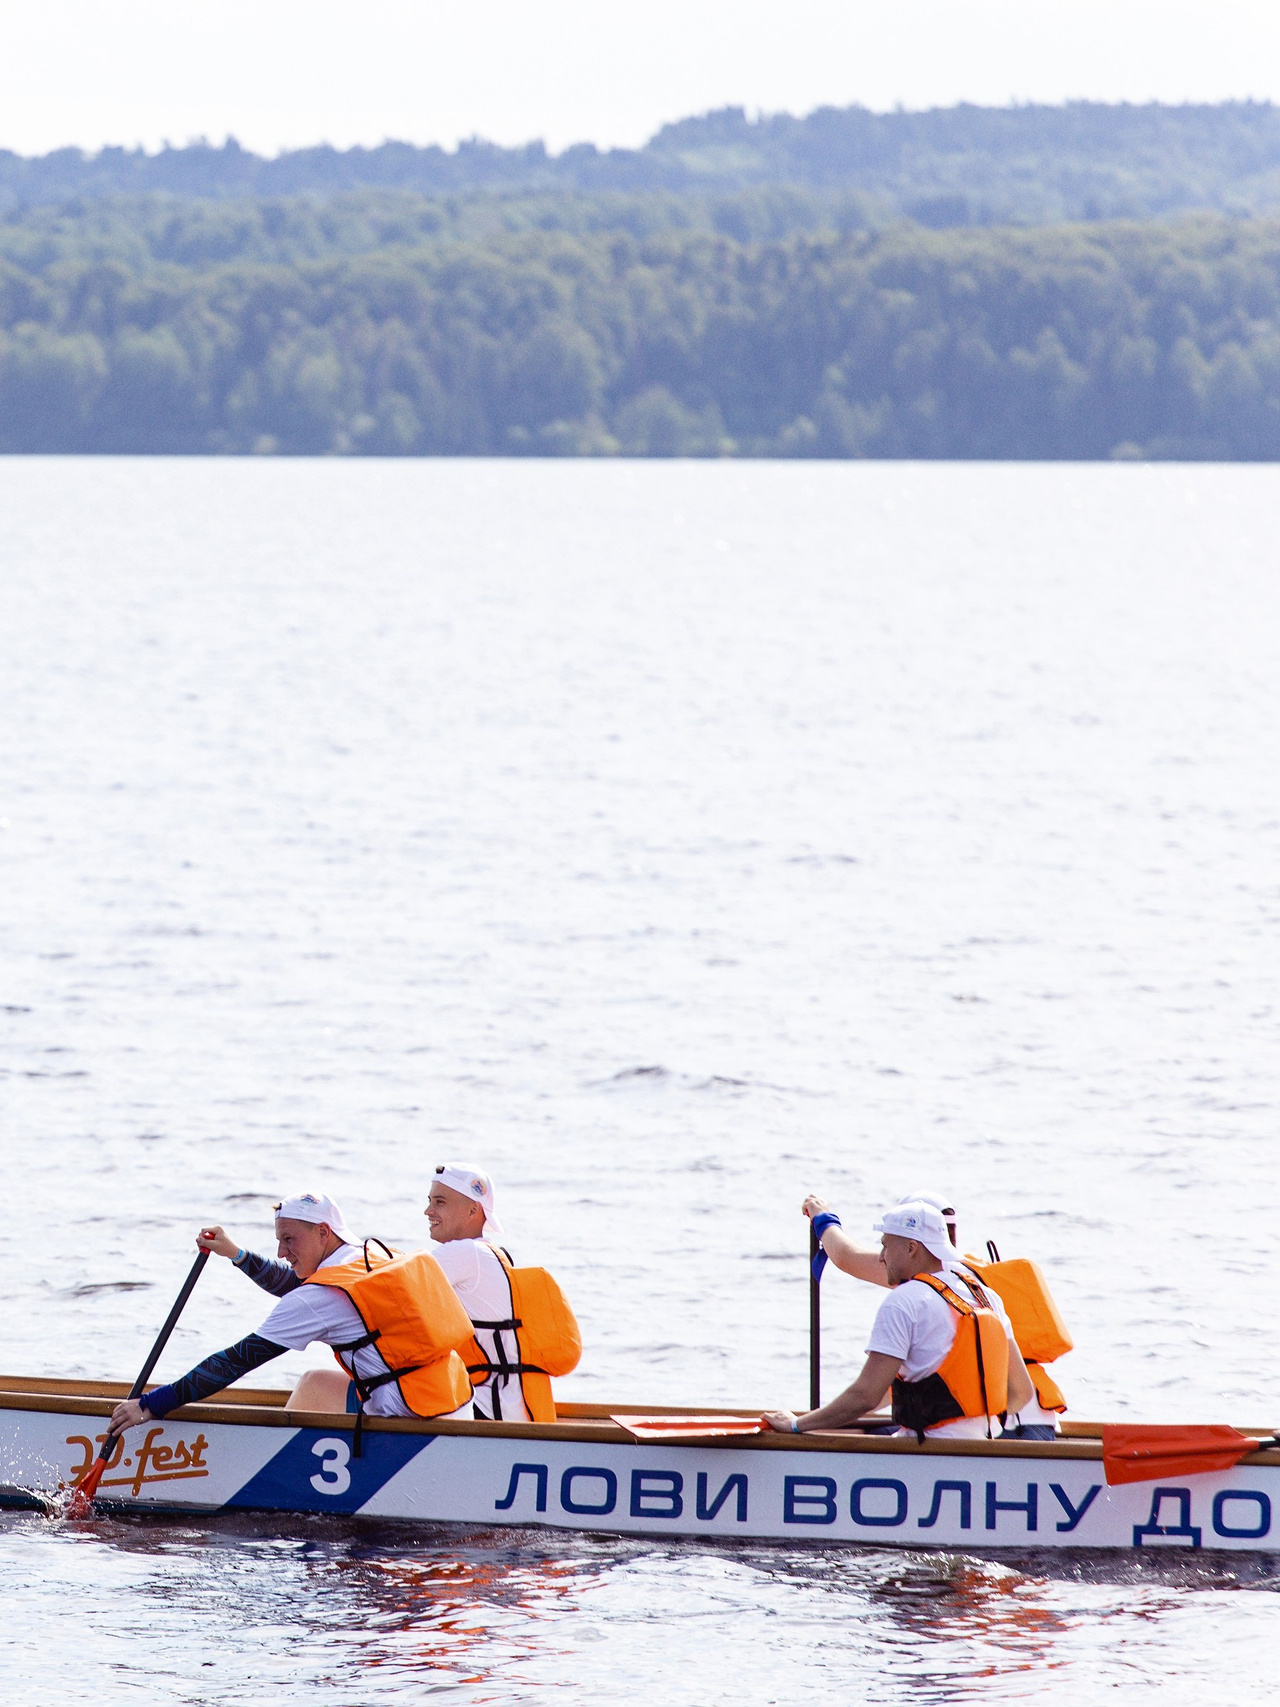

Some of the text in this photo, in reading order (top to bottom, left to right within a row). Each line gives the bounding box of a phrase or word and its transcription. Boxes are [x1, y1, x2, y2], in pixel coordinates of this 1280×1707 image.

[310, 1438, 351, 1495] 3
[494, 1462, 1271, 1547] ЛОВИ ВОЛНУ ДО
